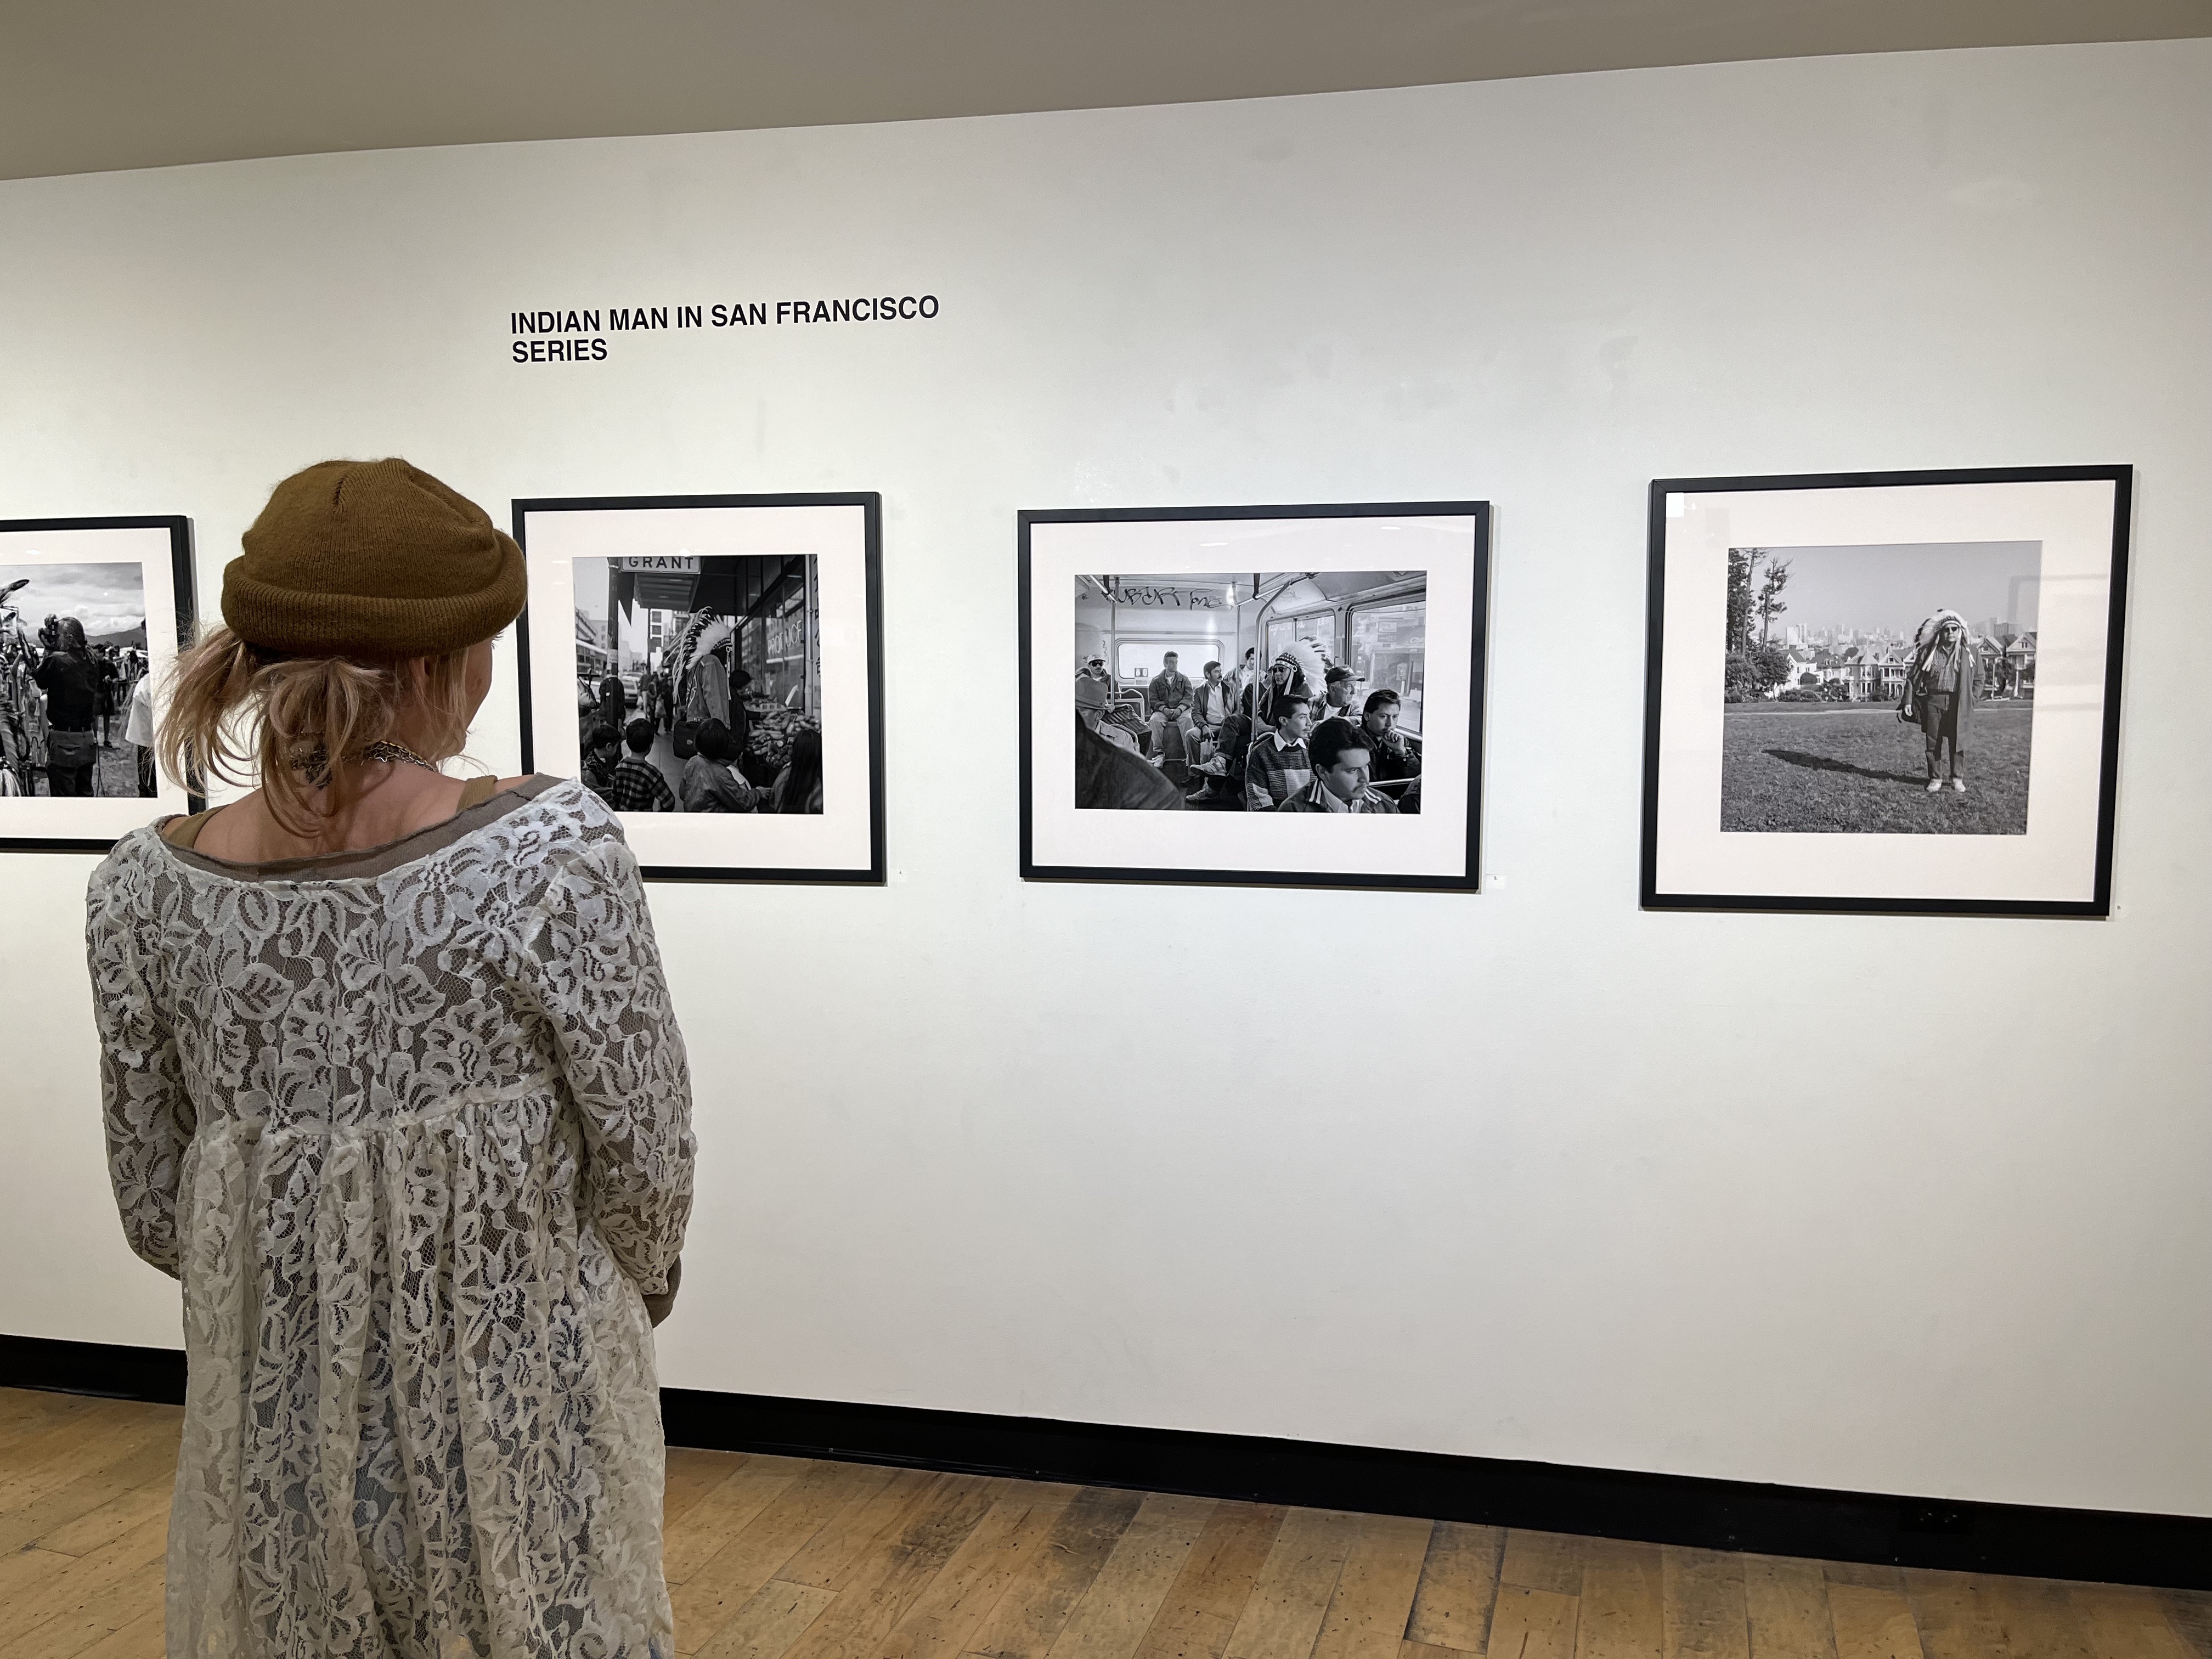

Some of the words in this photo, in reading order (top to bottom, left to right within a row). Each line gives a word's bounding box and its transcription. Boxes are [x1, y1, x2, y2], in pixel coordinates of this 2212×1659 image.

[511, 309, 601, 334] INDIAN
[610, 306, 668, 331] MAN
[677, 305, 702, 329] IN
[710, 302, 767, 328] SAN
[776, 295, 939, 324] FRANCISCO
[512, 338, 608, 364] SERIES
[628, 556, 693, 569] GRANT
